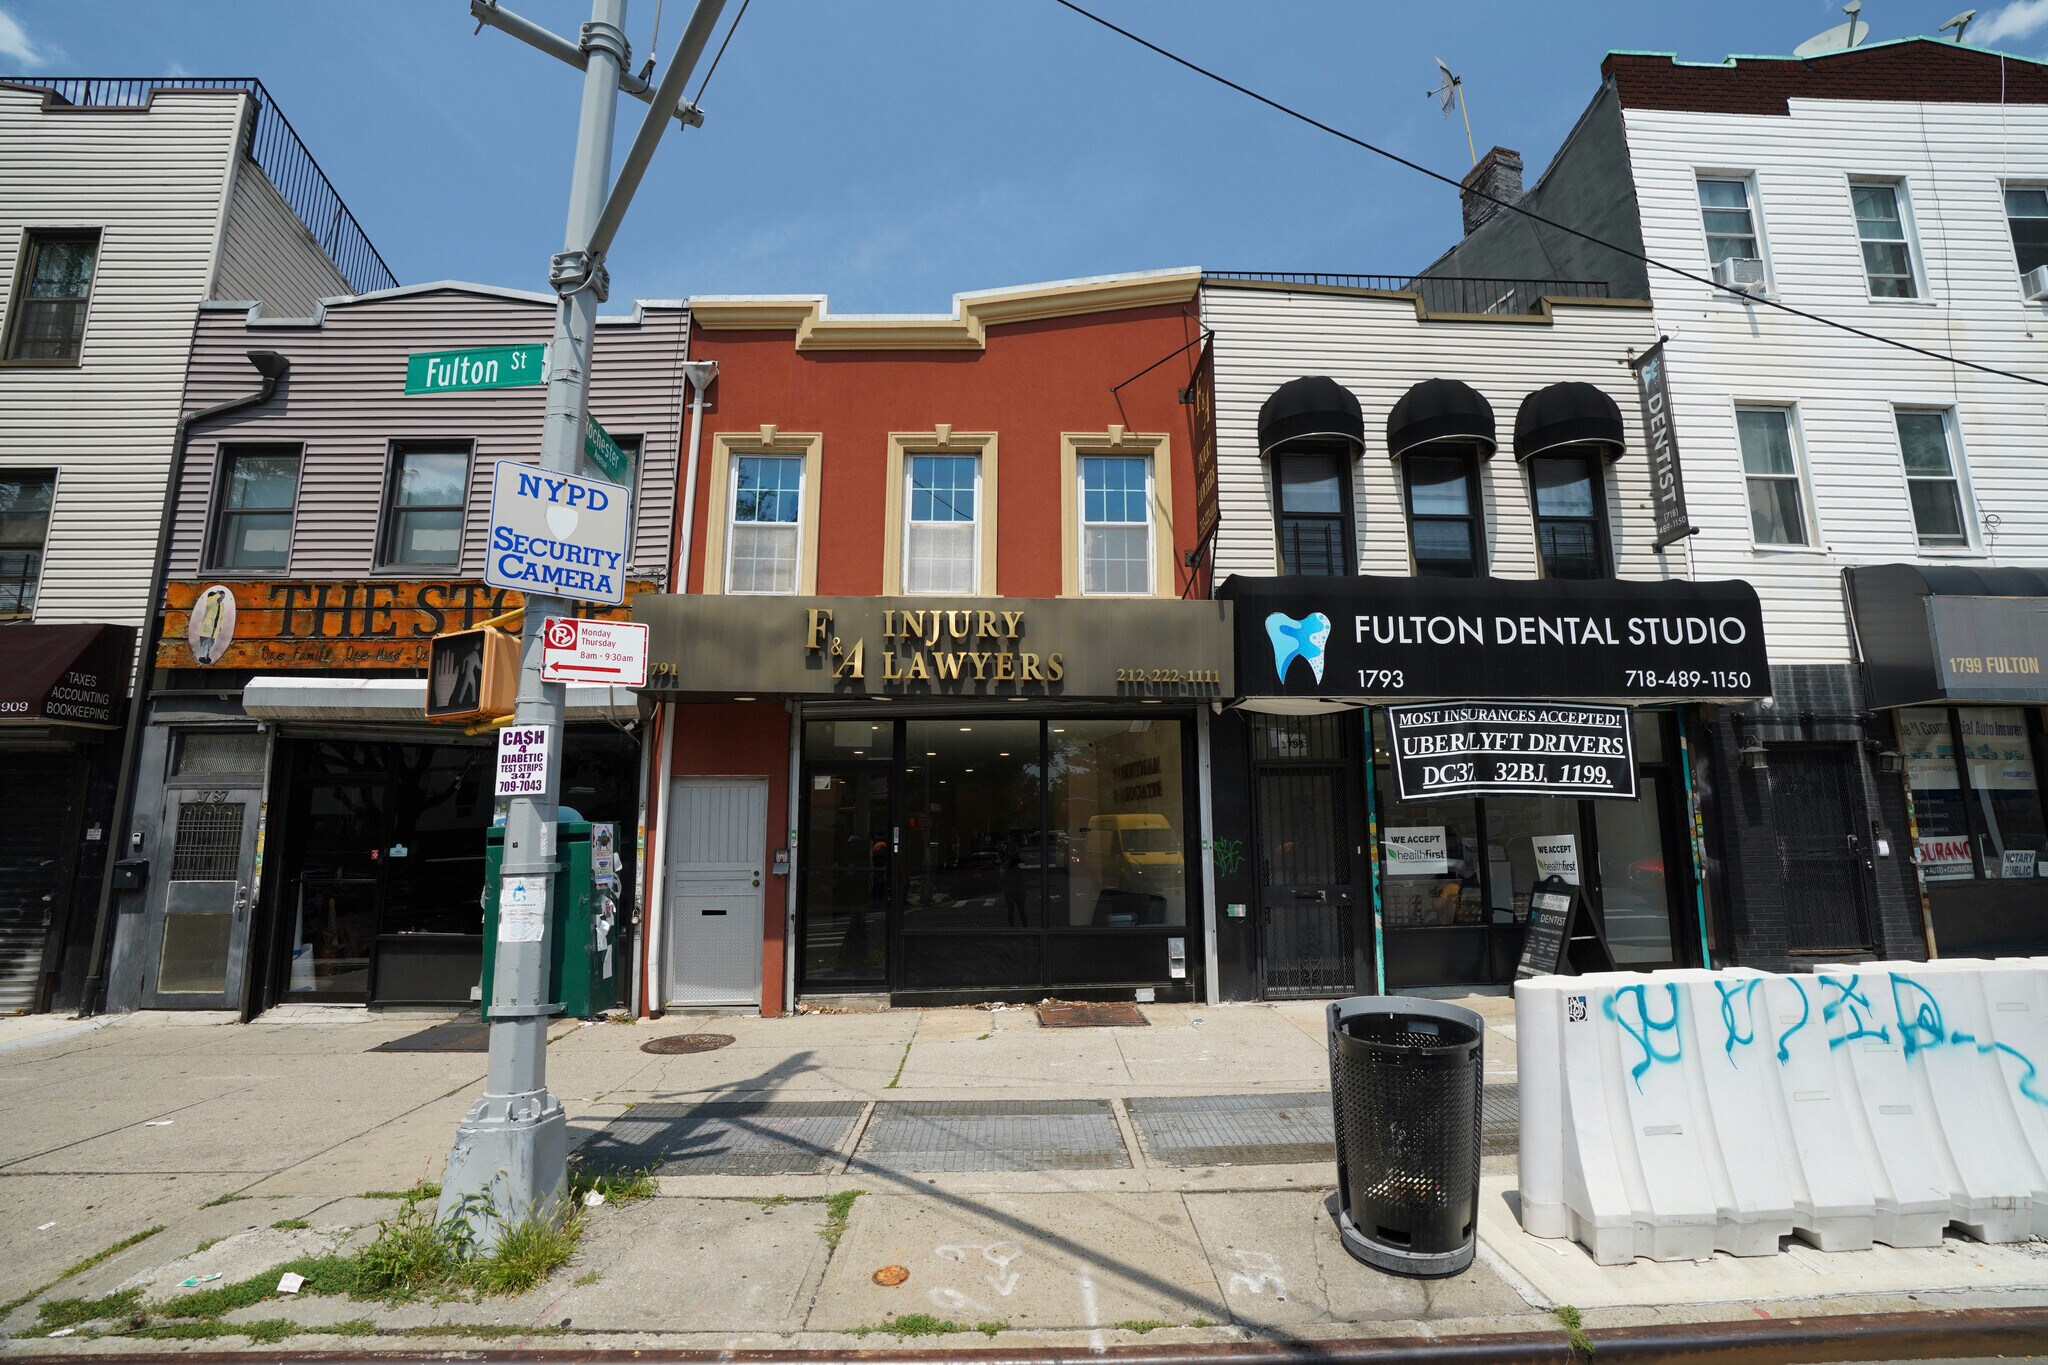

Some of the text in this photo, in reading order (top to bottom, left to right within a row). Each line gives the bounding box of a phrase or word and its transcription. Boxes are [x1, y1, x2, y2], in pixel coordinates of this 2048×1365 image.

[426, 352, 527, 387] Fulton St
[1647, 391, 1676, 502] DENTIST
[517, 473, 609, 511] NYPD
[1663, 507, 1679, 522] (718)
[493, 526, 621, 570] SECURITY
[498, 554, 613, 594] CAMERA
[269, 584, 399, 638] THE
[581, 628, 611, 639] Monday
[883, 609, 1024, 647] INJURY
[1355, 615, 1746, 645] FULTON DENTAL STUDIO
[581, 637, 616, 649] Thursday
[261, 646, 285, 661] One
[345, 646, 370, 661] One
[580, 651, 597, 660] 8am
[605, 653, 634, 662] 9:30am
[882, 651, 1064, 681] LAWYERS
[1950, 656, 2040, 674] 1799 FULTON
[69, 671, 97, 687] TAXES
[1358, 669, 1404, 689] 1793
[1625, 670, 1751, 689] 718-489-1150
[51, 686, 109, 705] ACCOUNTING
[46, 701, 109, 720] BOOKKEEPING
[1399, 708, 1620, 726] MOST INSURANCES ACCEPTED!
[1976, 722, 1994, 736] Auto
[1995, 723, 2022, 736] Insurer
[503, 730, 545, 746] CA$H
[1527, 733, 1624, 755] DRIVERS
[518, 745, 527, 753] 4
[501, 753, 543, 764] DIABETIC
[501, 763, 543, 773] TEST STRIPS
[1494, 762, 1548, 784] 32BJ,
[1558, 764, 1612, 785] 1199.
[499, 779, 542, 793] 709-7043
[1391, 836, 1406, 844] WE
[1397, 849, 1446, 860] healthfirst
[1537, 845, 1571, 854] WE ACCEPT
[2004, 865, 2031, 876] PUBLIC
[1540, 913, 1566, 926] DENTIST
